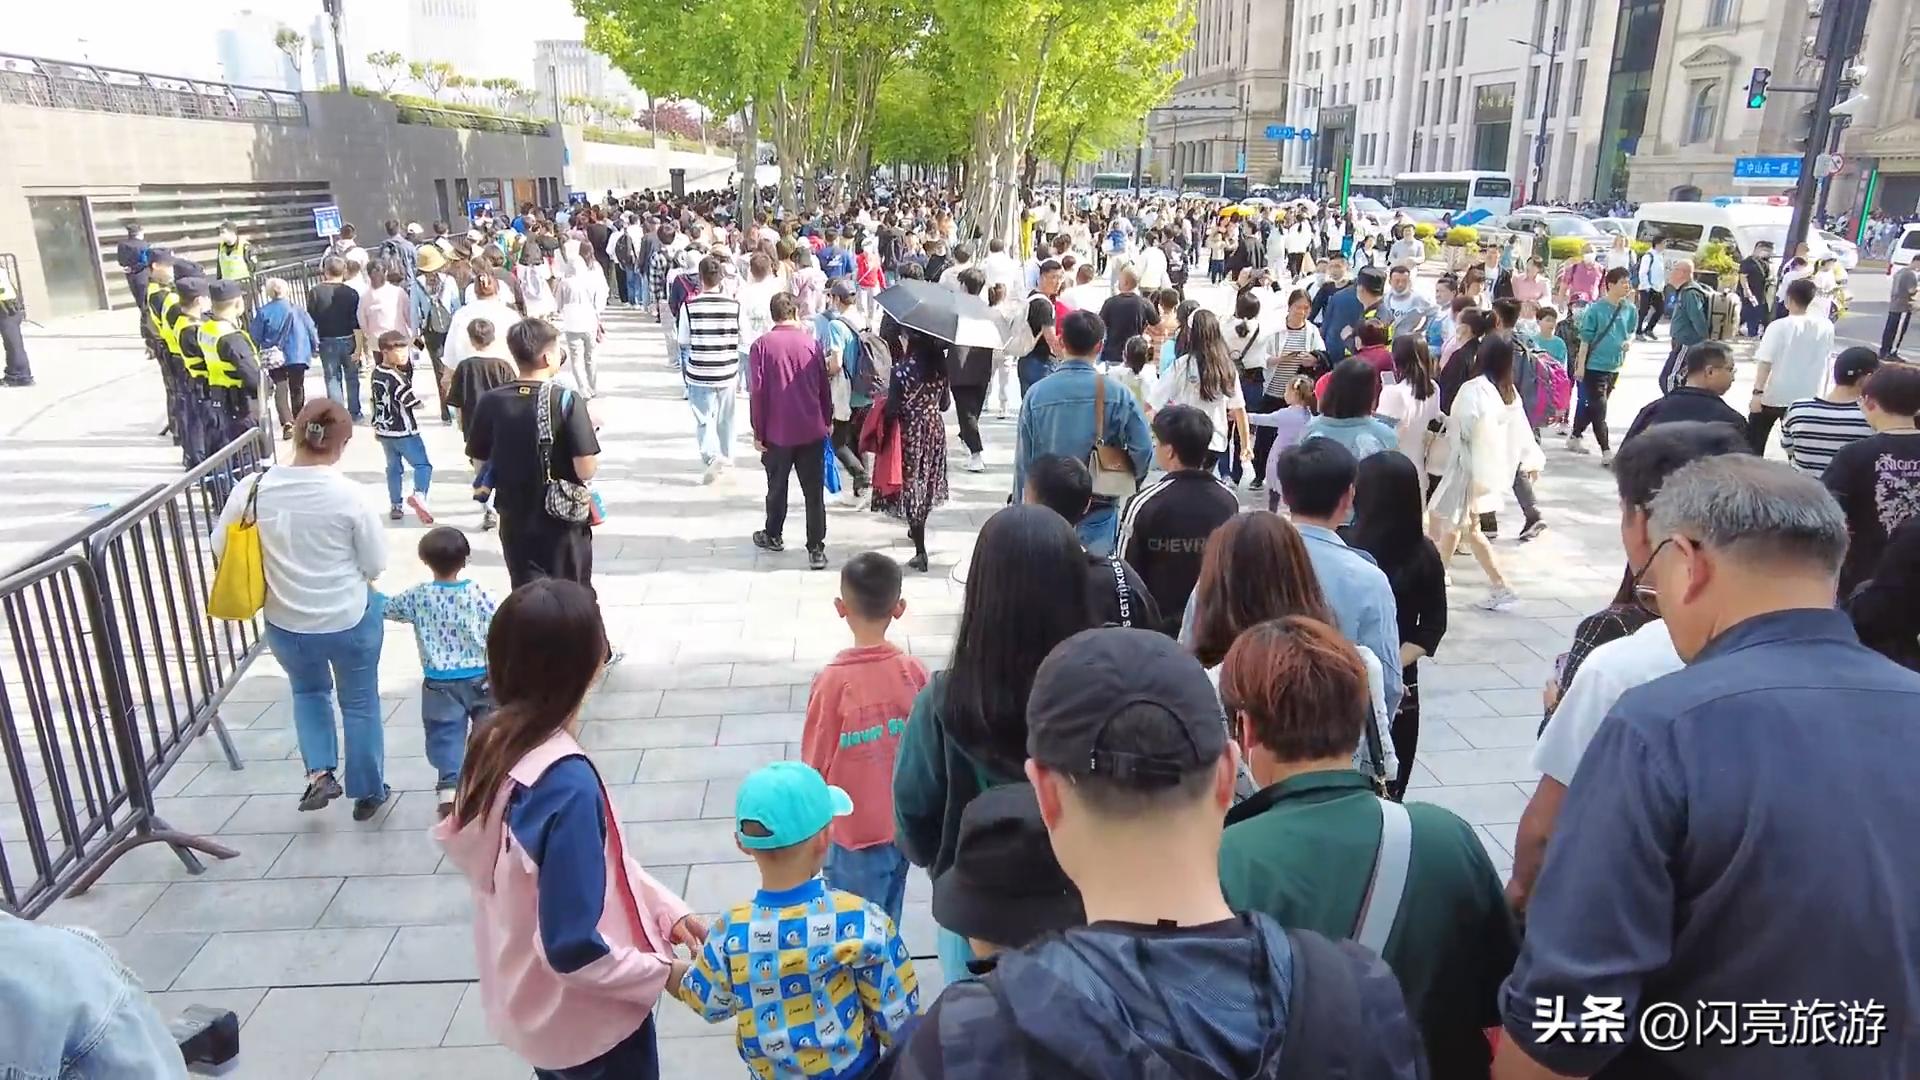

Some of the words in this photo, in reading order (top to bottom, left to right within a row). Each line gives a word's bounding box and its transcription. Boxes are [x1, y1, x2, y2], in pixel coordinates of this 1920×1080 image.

[1746, 161, 1790, 175] 中山东一路
